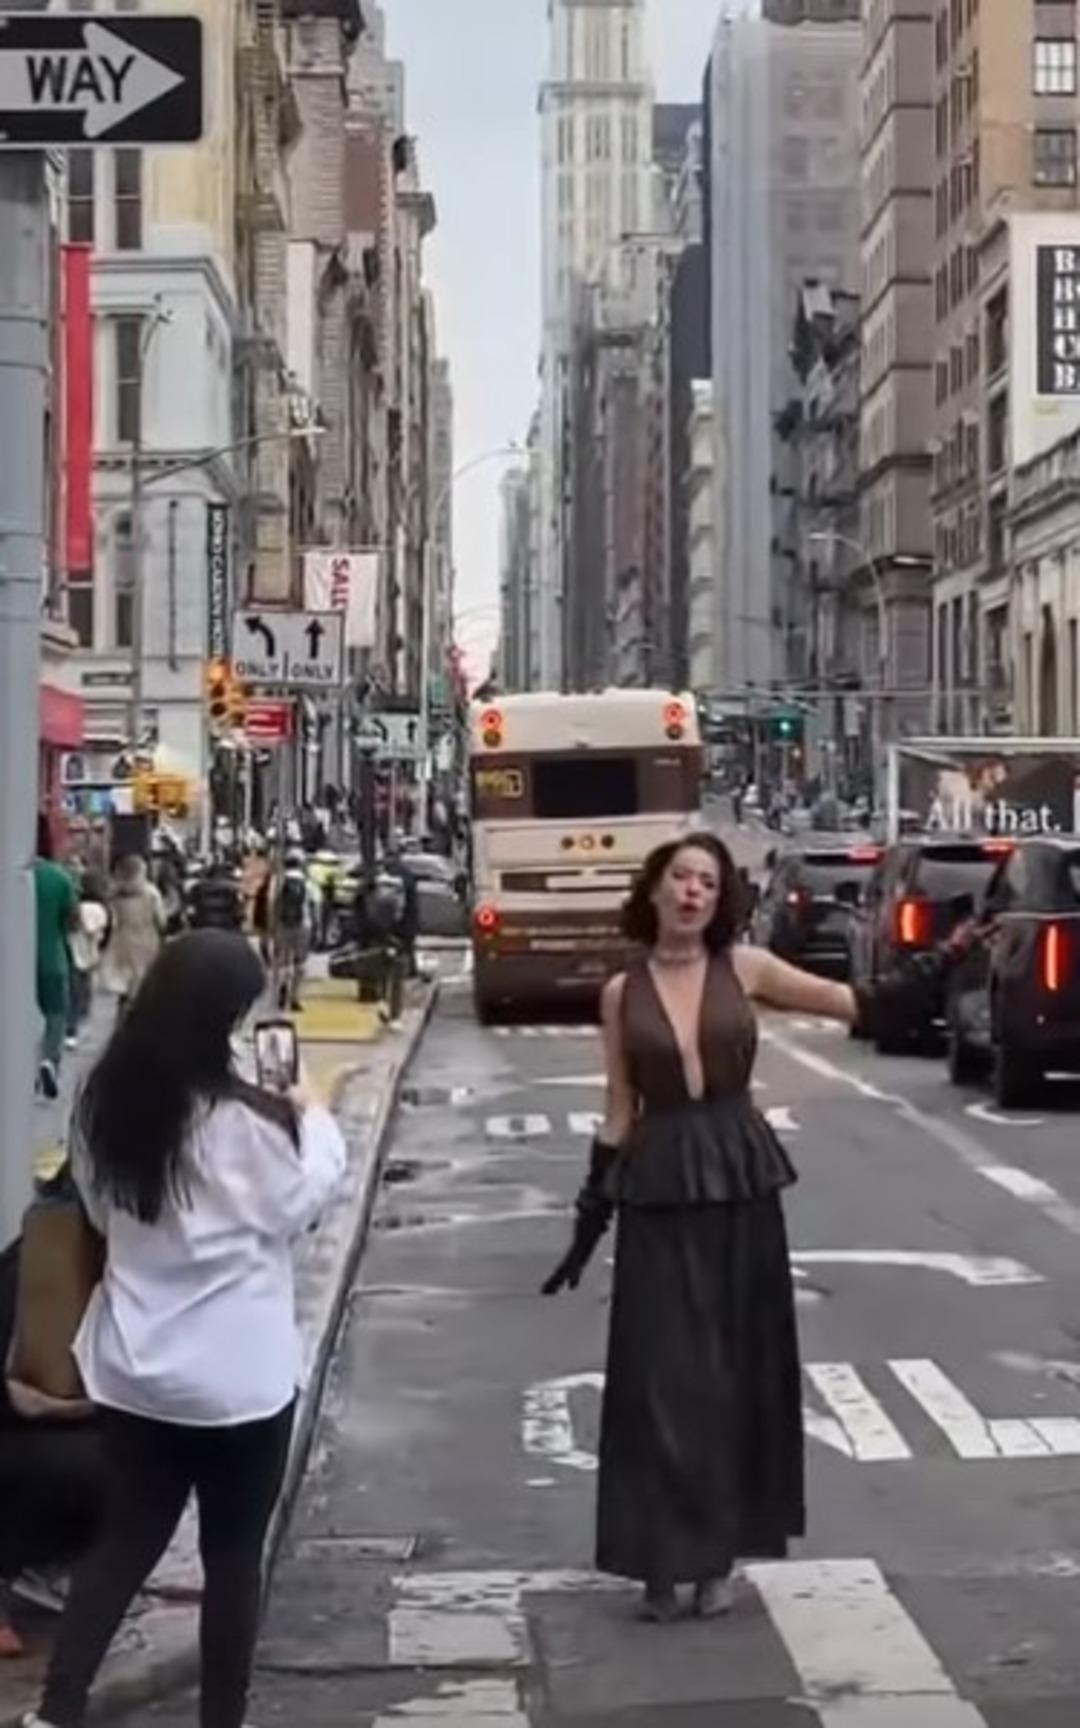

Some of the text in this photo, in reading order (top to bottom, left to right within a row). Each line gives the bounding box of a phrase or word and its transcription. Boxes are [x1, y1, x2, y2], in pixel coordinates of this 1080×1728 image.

[26, 55, 136, 104] WAY
[235, 660, 279, 678] ONLY
[292, 663, 333, 680] ONLY
[922, 797, 1061, 832] All that.
